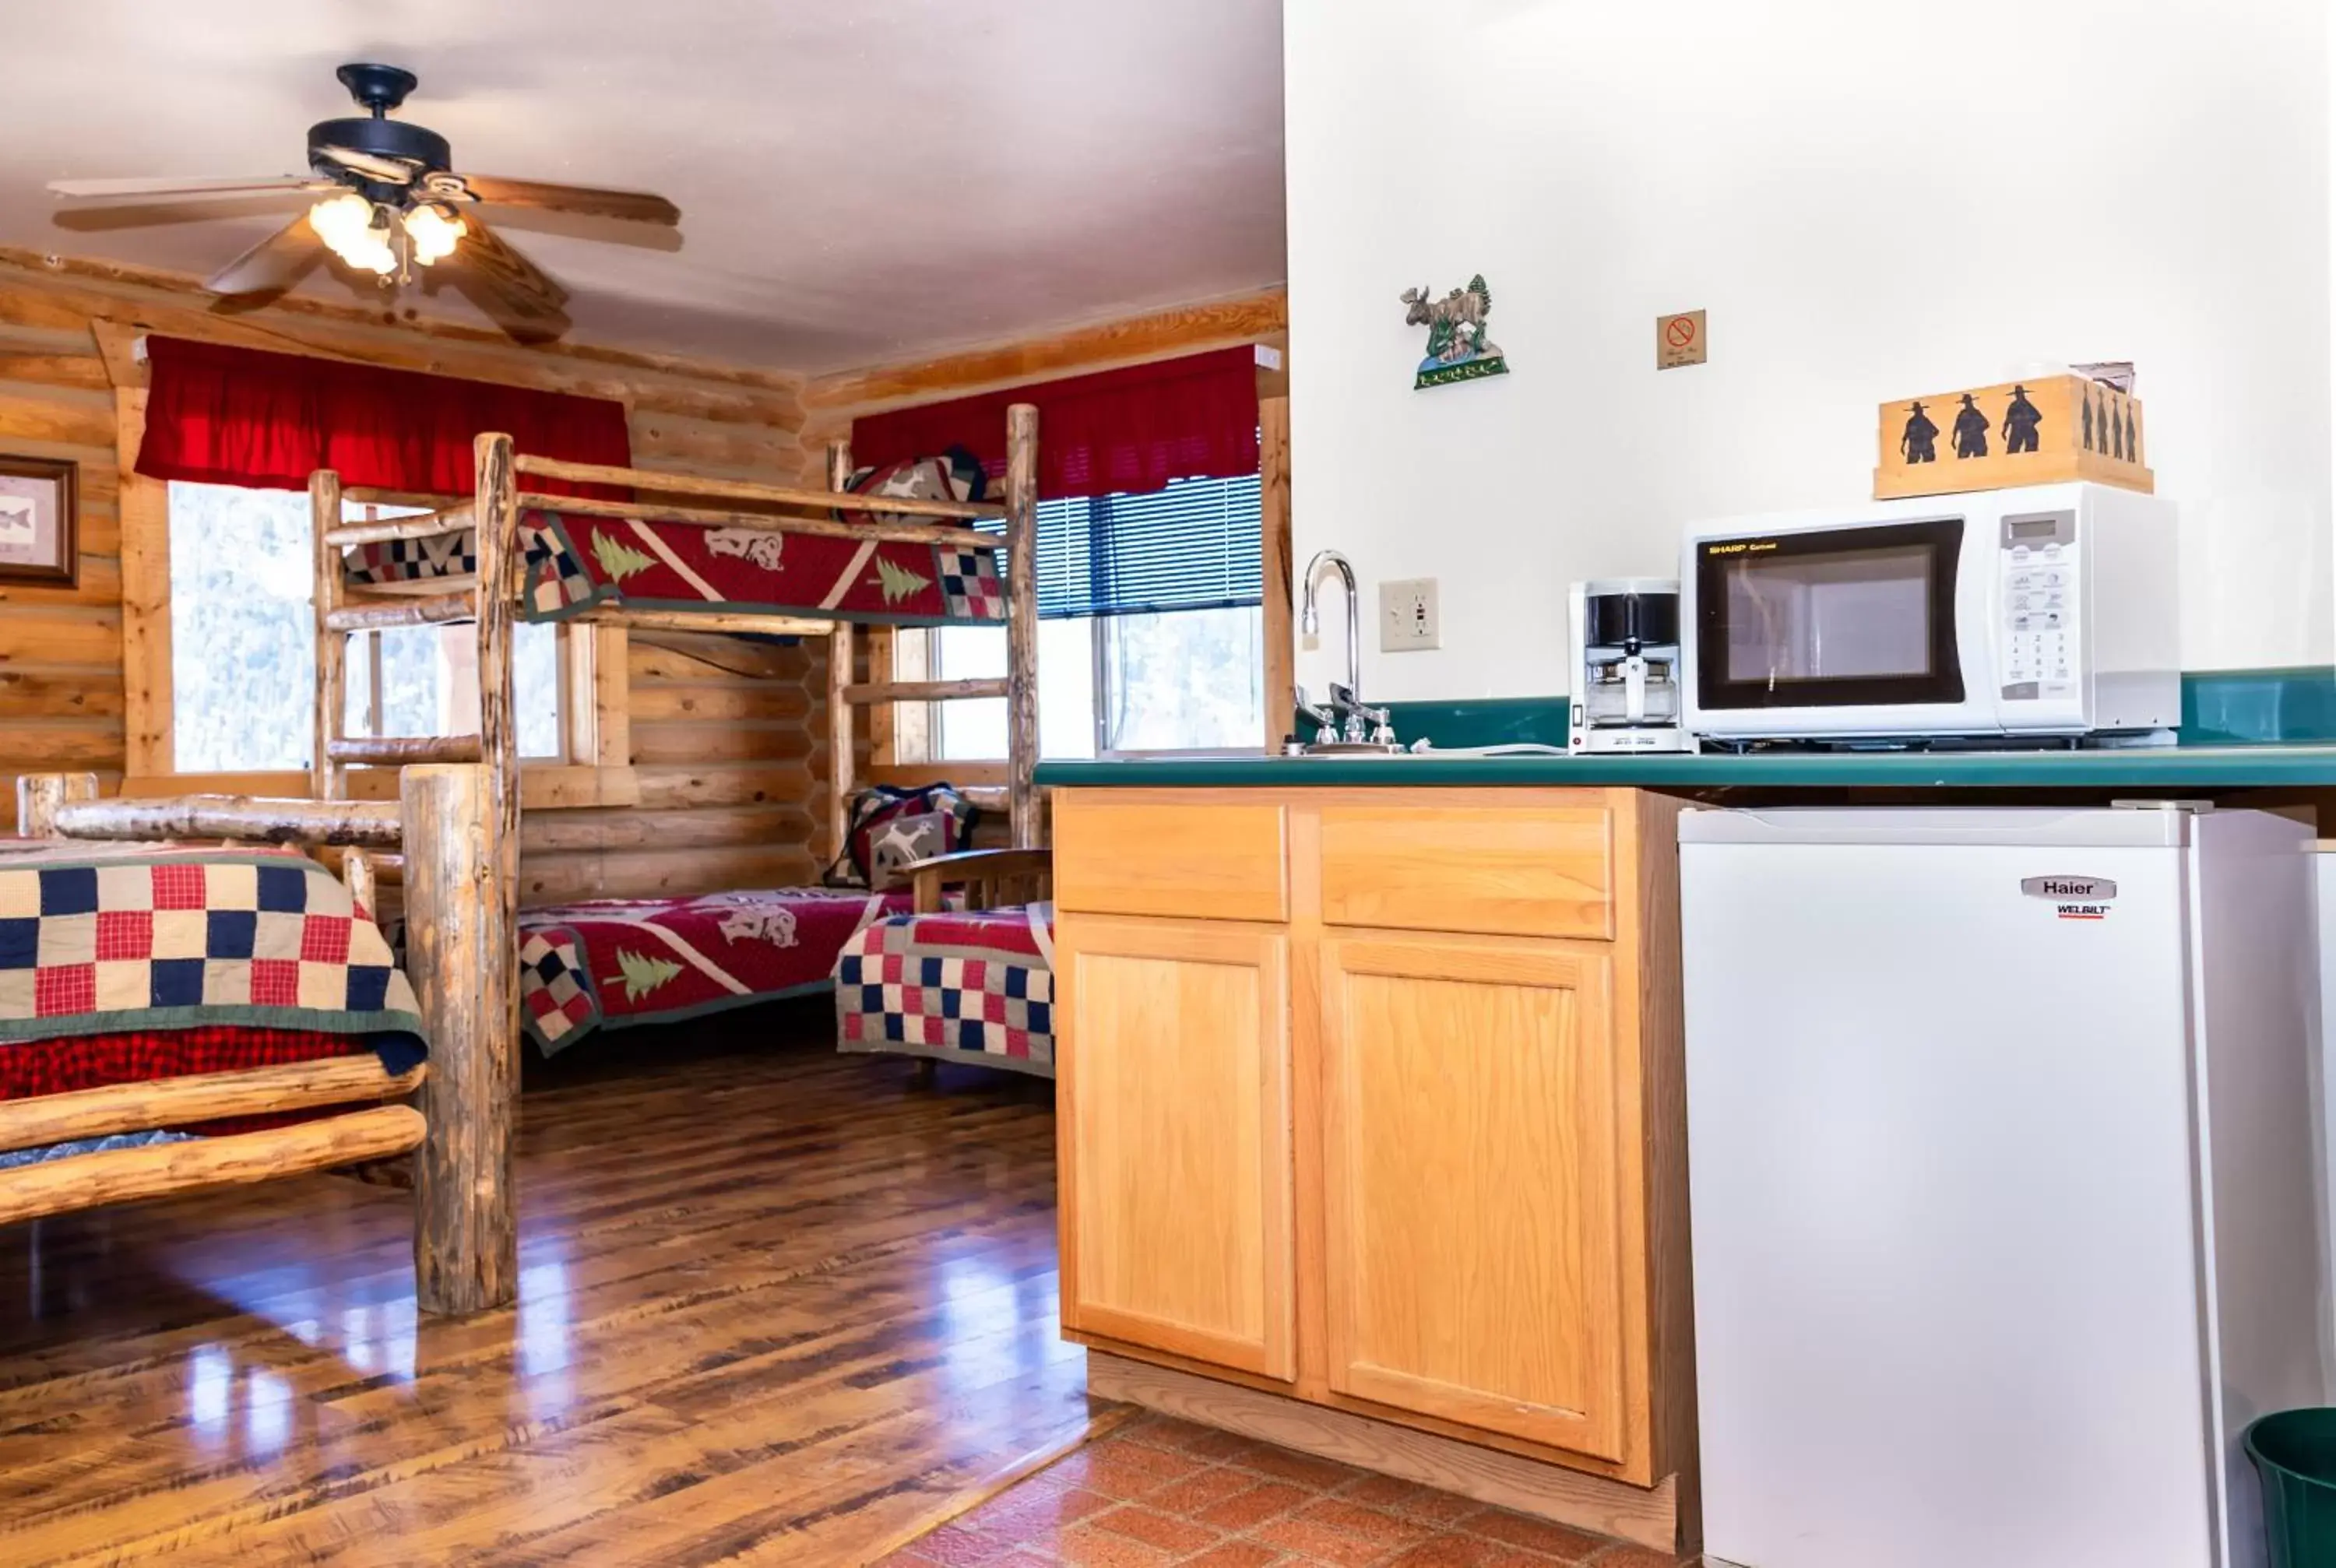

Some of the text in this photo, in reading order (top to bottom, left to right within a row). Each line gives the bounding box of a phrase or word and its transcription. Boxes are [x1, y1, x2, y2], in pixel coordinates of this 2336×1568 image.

[1709, 545, 1746, 554] SHARP
[2043, 881, 2094, 895] Haier
[2057, 905, 2106, 914] WELBILT
